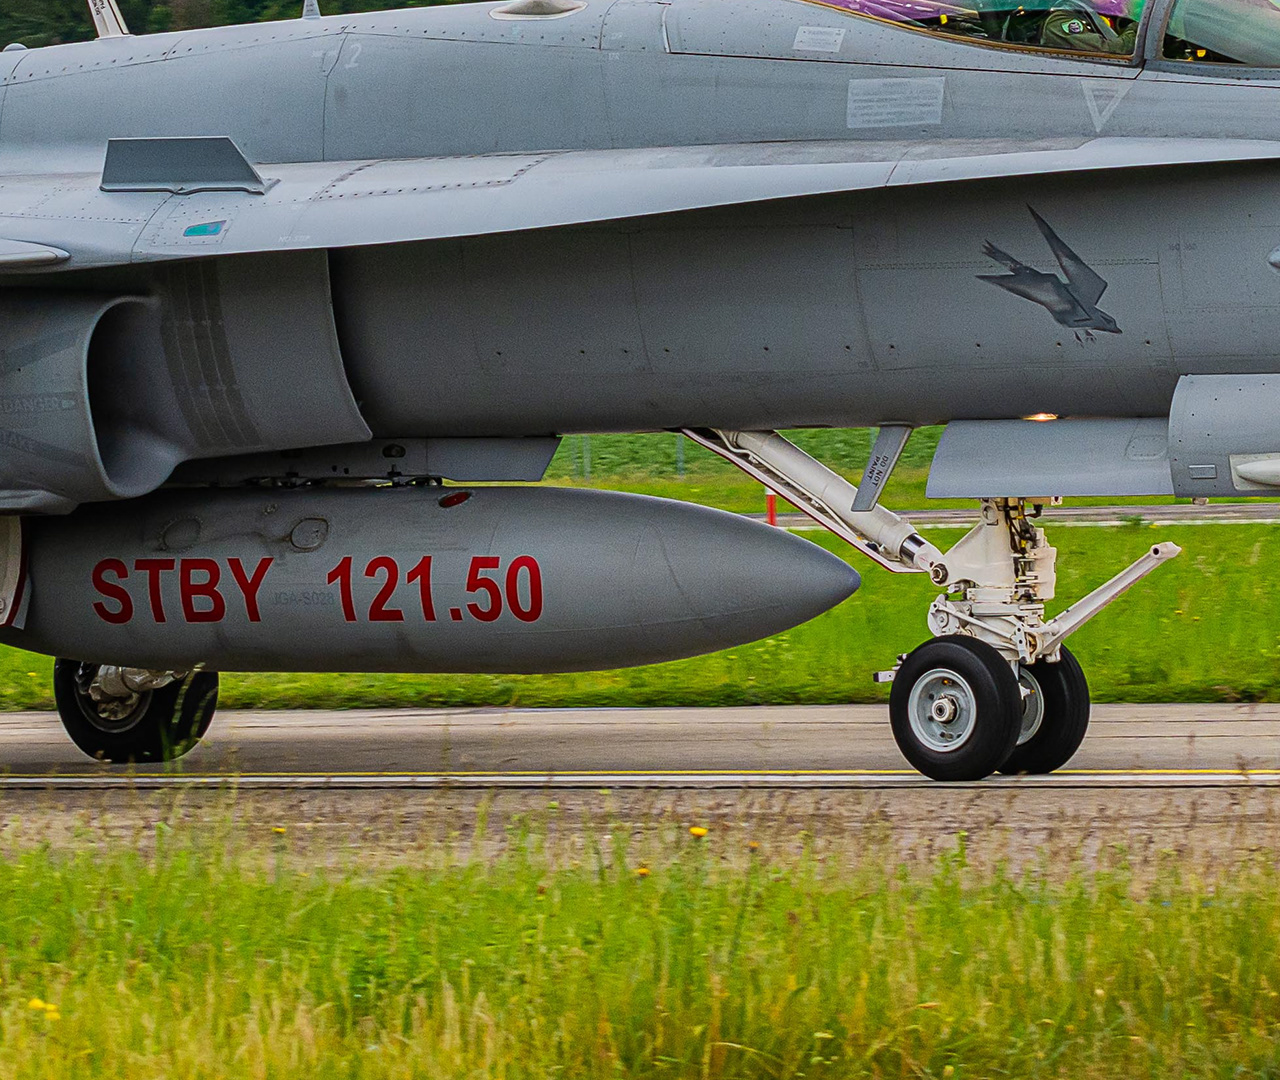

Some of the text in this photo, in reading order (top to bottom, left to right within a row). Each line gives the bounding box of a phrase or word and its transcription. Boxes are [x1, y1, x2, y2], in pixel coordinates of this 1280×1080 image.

[2, 396, 60, 414] DANGER
[867, 456, 880, 480] PAINT
[872, 455, 889, 487] DO NOT
[90, 554, 544, 625] STBY 121.50
